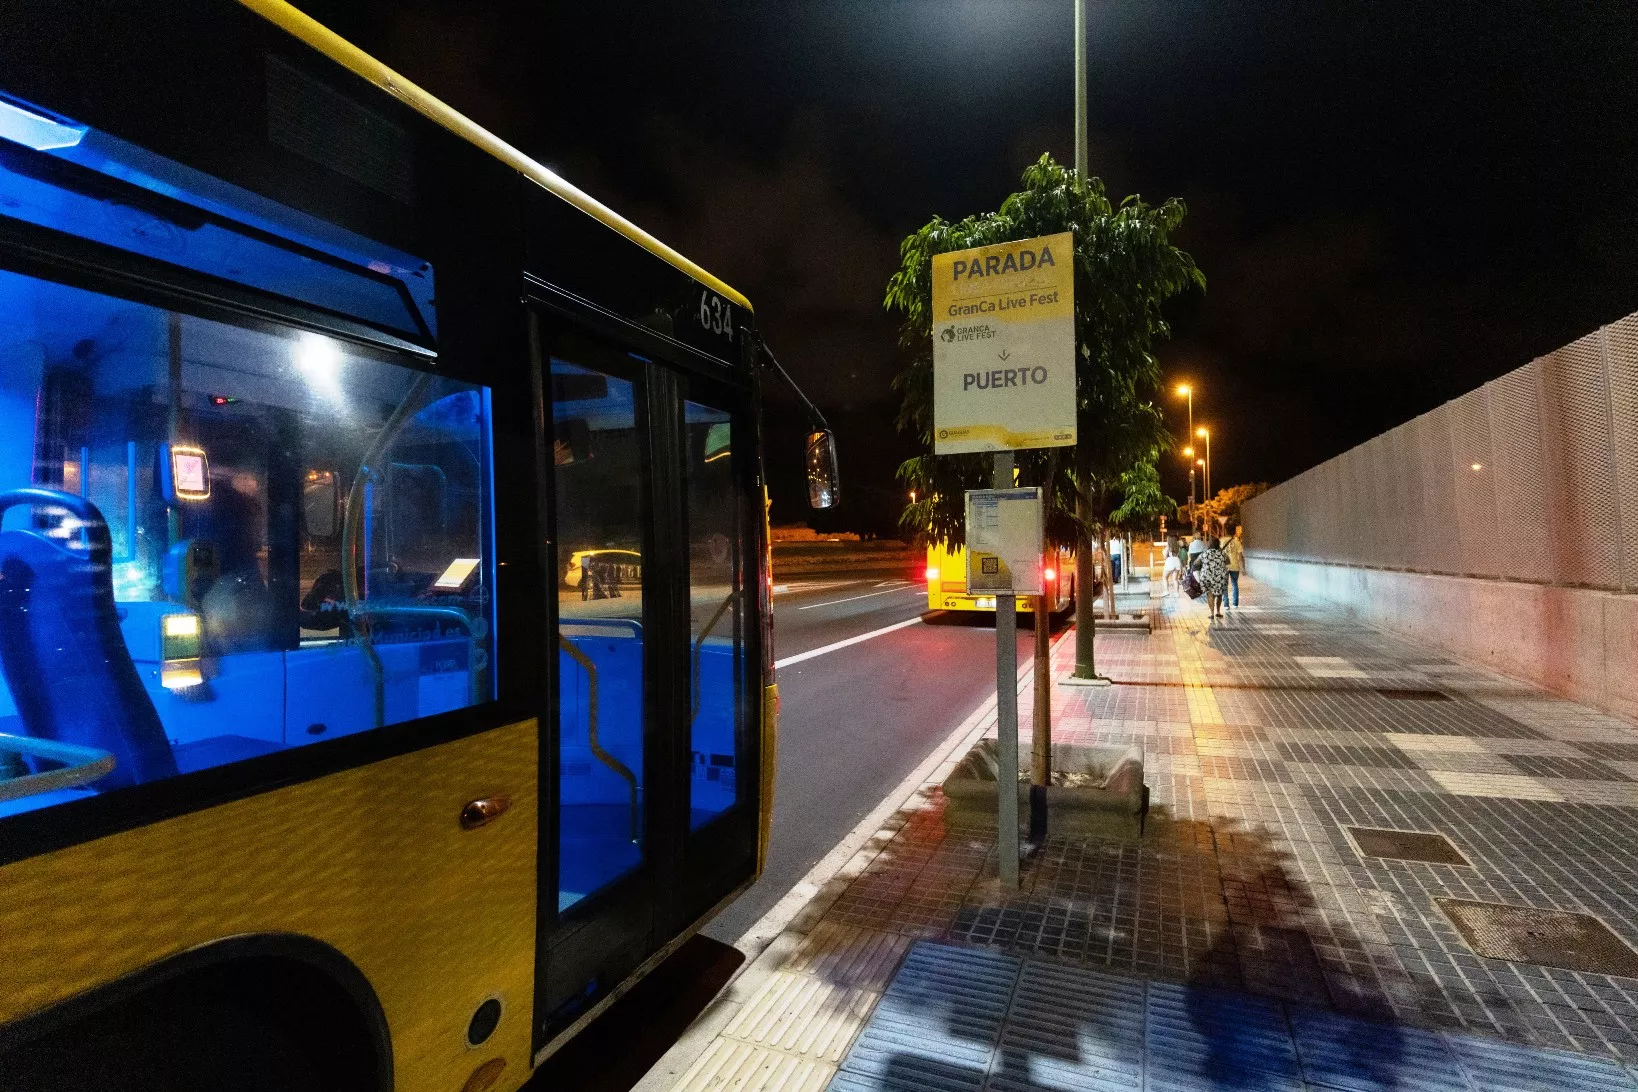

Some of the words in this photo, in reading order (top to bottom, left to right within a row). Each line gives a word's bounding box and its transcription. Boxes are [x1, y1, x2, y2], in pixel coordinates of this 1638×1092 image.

[953, 244, 1056, 281] PARADA
[700, 290, 734, 342] 634
[948, 300, 996, 316] GranCa
[998, 297, 1027, 311] Live
[1029, 291, 1059, 306] Fest
[957, 324, 990, 335] GRANCA
[957, 334, 975, 342] LIVE
[976, 330, 997, 340] FEST
[963, 365, 1048, 392] PUERTO
